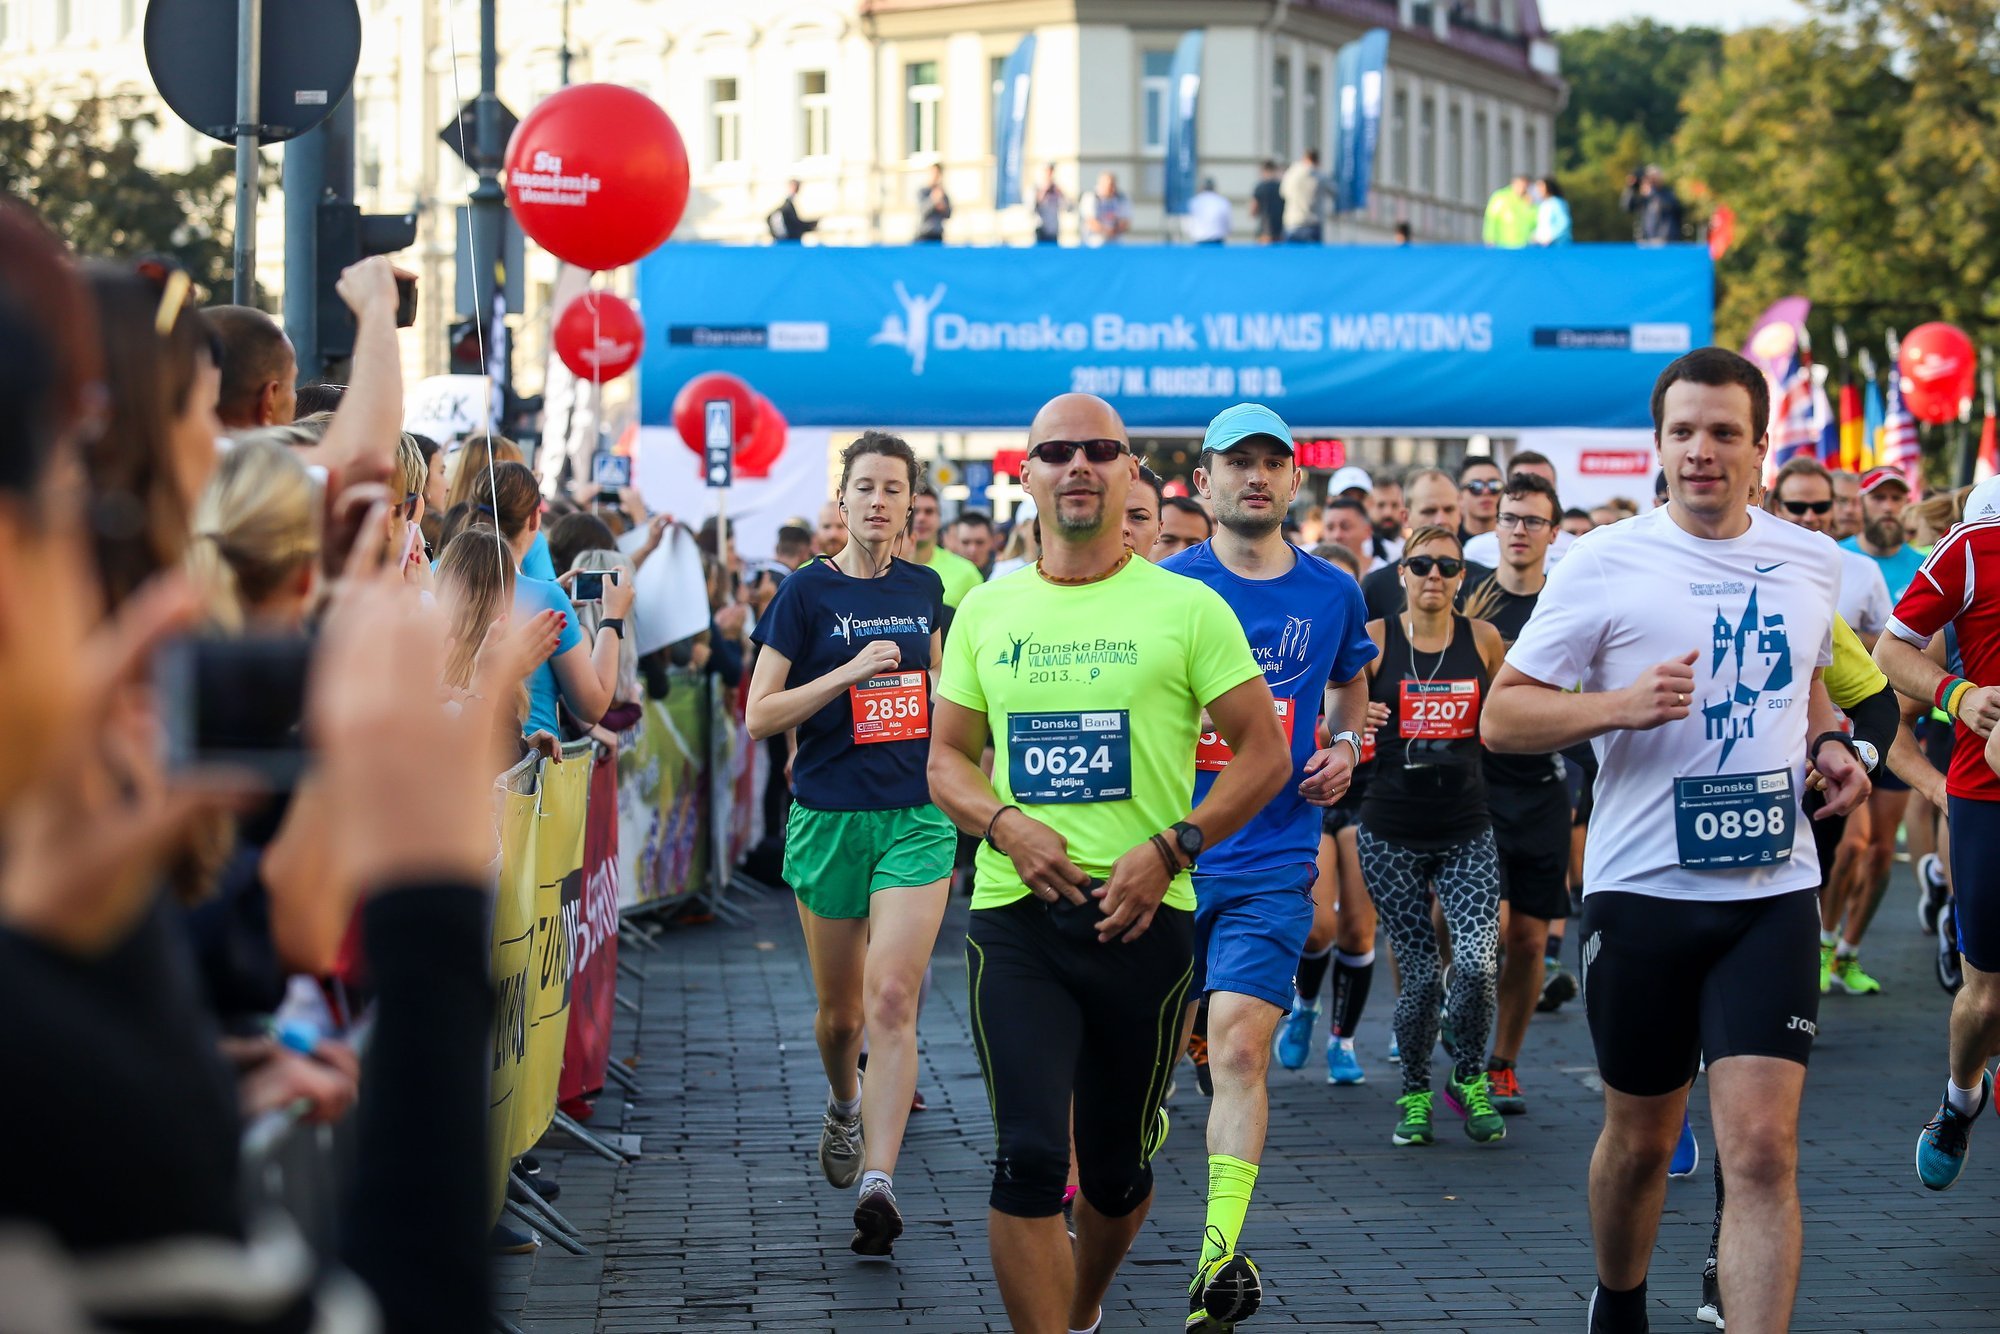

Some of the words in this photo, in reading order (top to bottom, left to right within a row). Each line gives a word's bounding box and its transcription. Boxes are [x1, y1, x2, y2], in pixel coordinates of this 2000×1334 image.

[933, 313, 1088, 351] Danske
[1093, 312, 1197, 351] Bank
[1203, 312, 1323, 351] VILNIAUS
[1329, 312, 1492, 352] MARATONAS
[1071, 366, 1121, 396] 2017
[852, 616, 890, 629] Danske
[890, 616, 915, 625] Bank
[854, 626, 883, 637] VILNIAUS
[1028, 640, 1091, 655] Danske
[1094, 638, 1137, 652] Bank
[1028, 652, 1072, 668] VILNIAUS
[1075, 651, 1138, 666] MARATONAS
[868, 678, 900, 688] Danske
[903, 676, 920, 685] Bank
[1418, 683, 1450, 692] Danske
[864, 695, 920, 721] 2856
[1411, 700, 1470, 721] 2207
[1031, 718, 1079, 730] Danske
[1085, 717, 1117, 728] Bank
[1024, 745, 1113, 775] 0624
[1050, 777, 1085, 788] Egidijus
[1703, 782, 1754, 794] Danske
[1760, 778, 1786, 789] Bank
[1694, 805, 1785, 841] 0898
